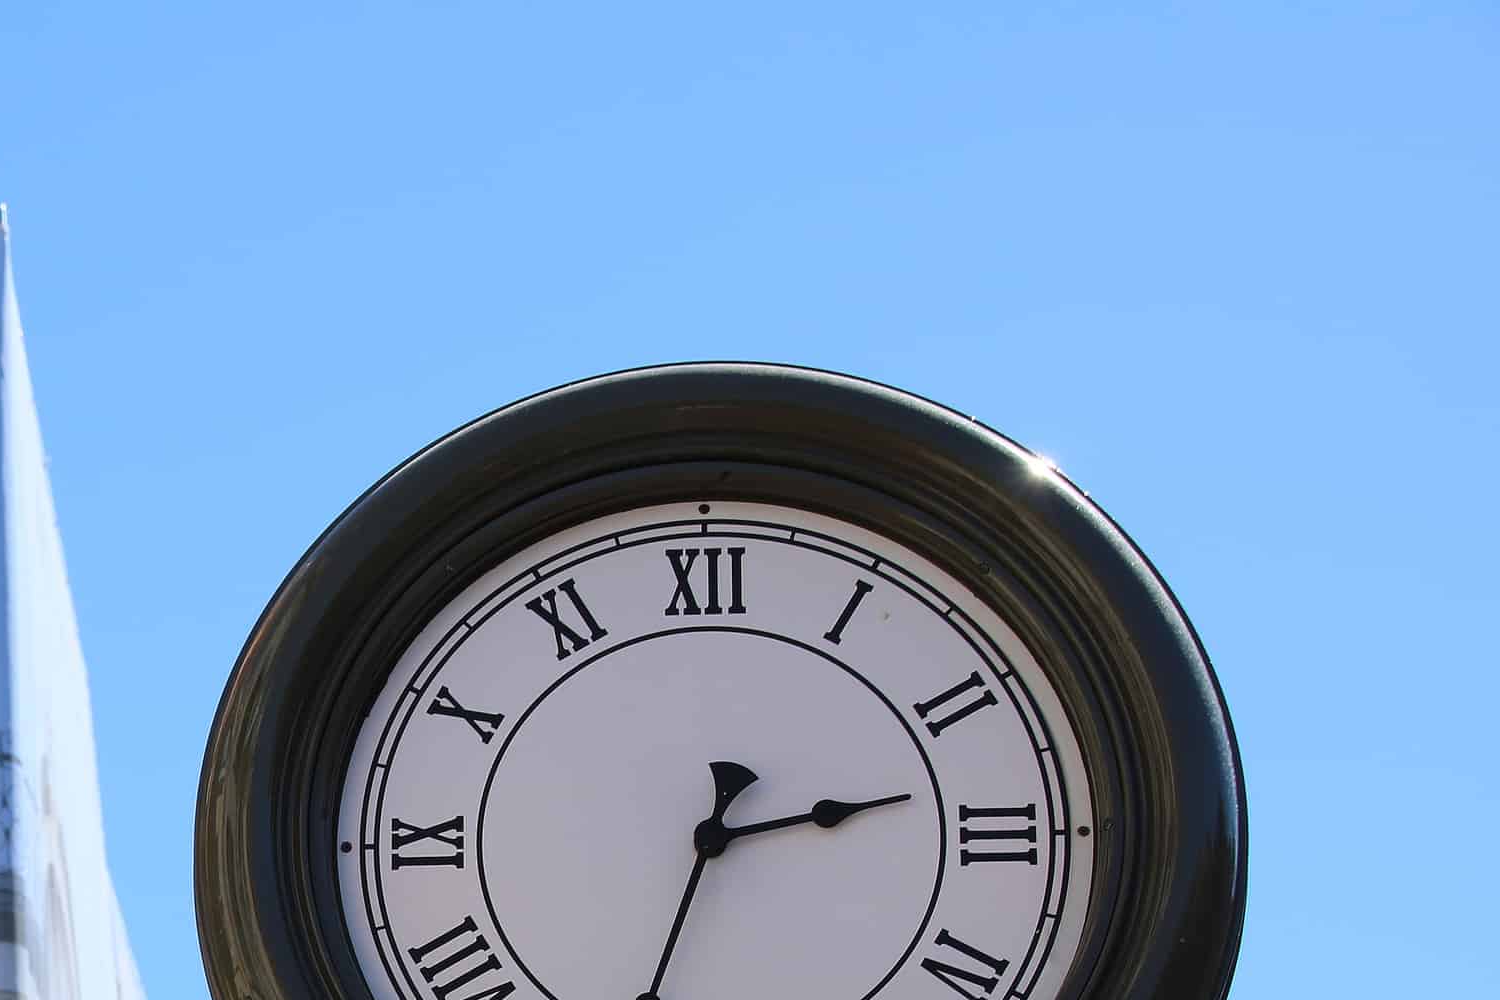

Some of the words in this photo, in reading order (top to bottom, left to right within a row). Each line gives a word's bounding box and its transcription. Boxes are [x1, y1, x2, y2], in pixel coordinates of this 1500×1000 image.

[665, 547, 746, 616] XII
[823, 579, 873, 645] I
[525, 578, 608, 661] XI
[427, 686, 505, 744] X
[913, 671, 998, 738] II
[392, 816, 464, 870] IX
[959, 804, 1037, 866] III
